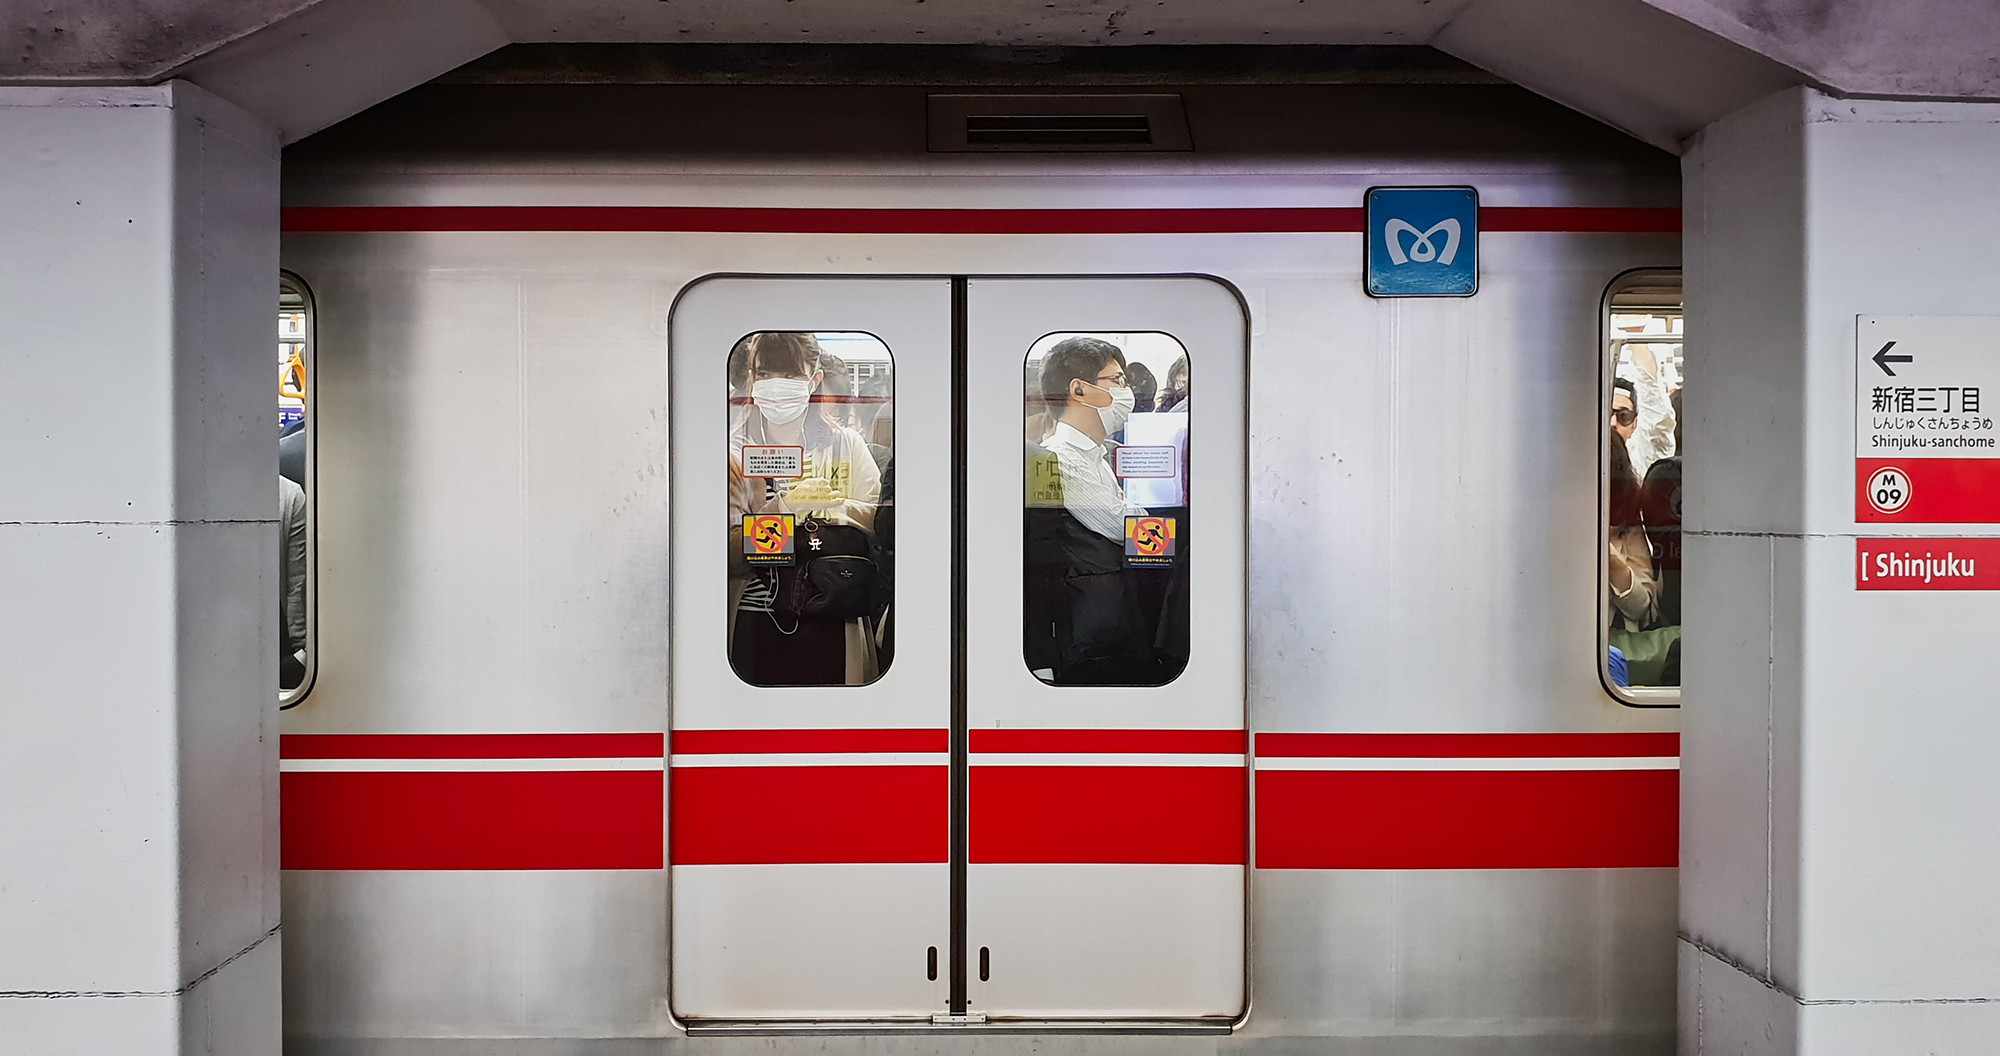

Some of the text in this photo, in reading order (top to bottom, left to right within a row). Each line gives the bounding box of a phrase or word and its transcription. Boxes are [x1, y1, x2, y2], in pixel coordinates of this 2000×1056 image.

[1872, 386, 1979, 413] 新宿三丁目
[1873, 417, 1993, 431] しんじゅくさんちょうめ
[1872, 435, 1995, 450] Shinjuku-sanchome
[1882, 474, 1896, 486] M
[1876, 489, 1901, 505] 09
[1876, 552, 1975, 584] Shinjuku
